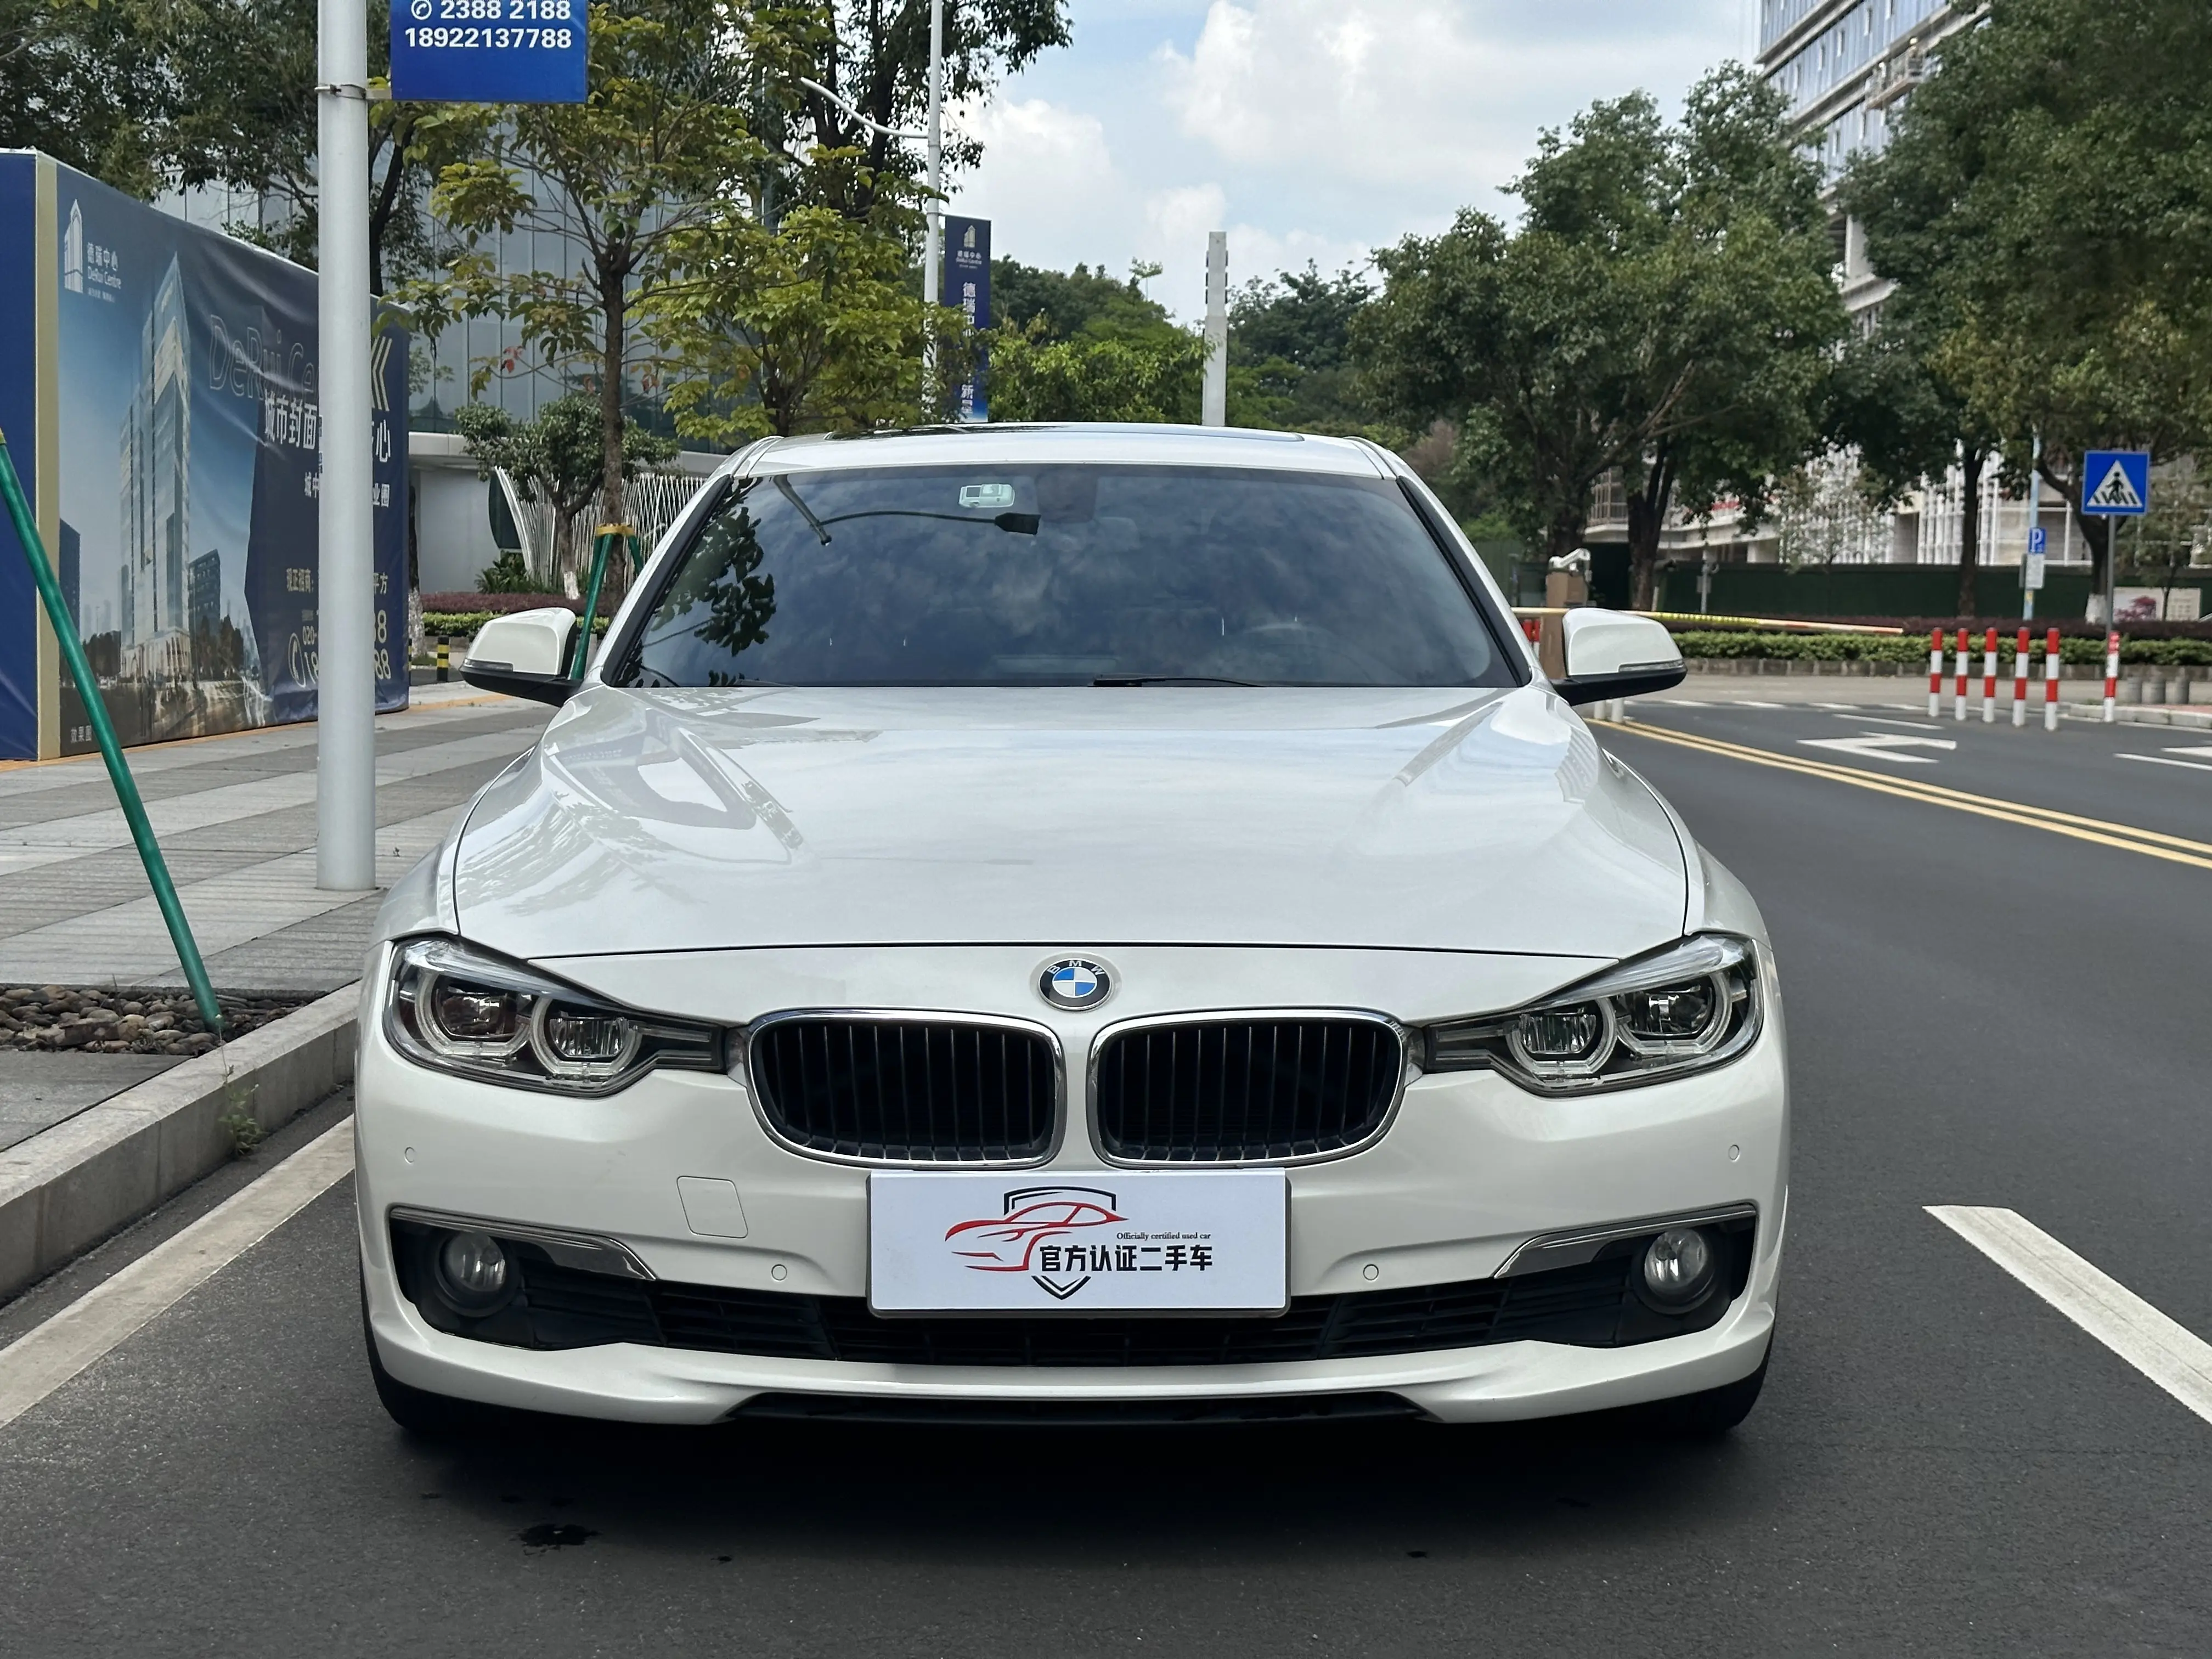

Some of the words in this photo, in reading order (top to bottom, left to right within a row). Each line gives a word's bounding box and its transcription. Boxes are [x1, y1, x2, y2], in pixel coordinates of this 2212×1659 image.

[441, 0, 501, 19] 2388
[509, 0, 571, 20] 2188
[405, 27, 572, 48] 18922137788
[264, 389, 317, 449] 城市封面
[2032, 528, 2044, 552] P
[1047, 960, 1105, 975] BMW
[1116, 1232, 1149, 1241] Officially
[1040, 1244, 1212, 1271] 官方认证二手车
